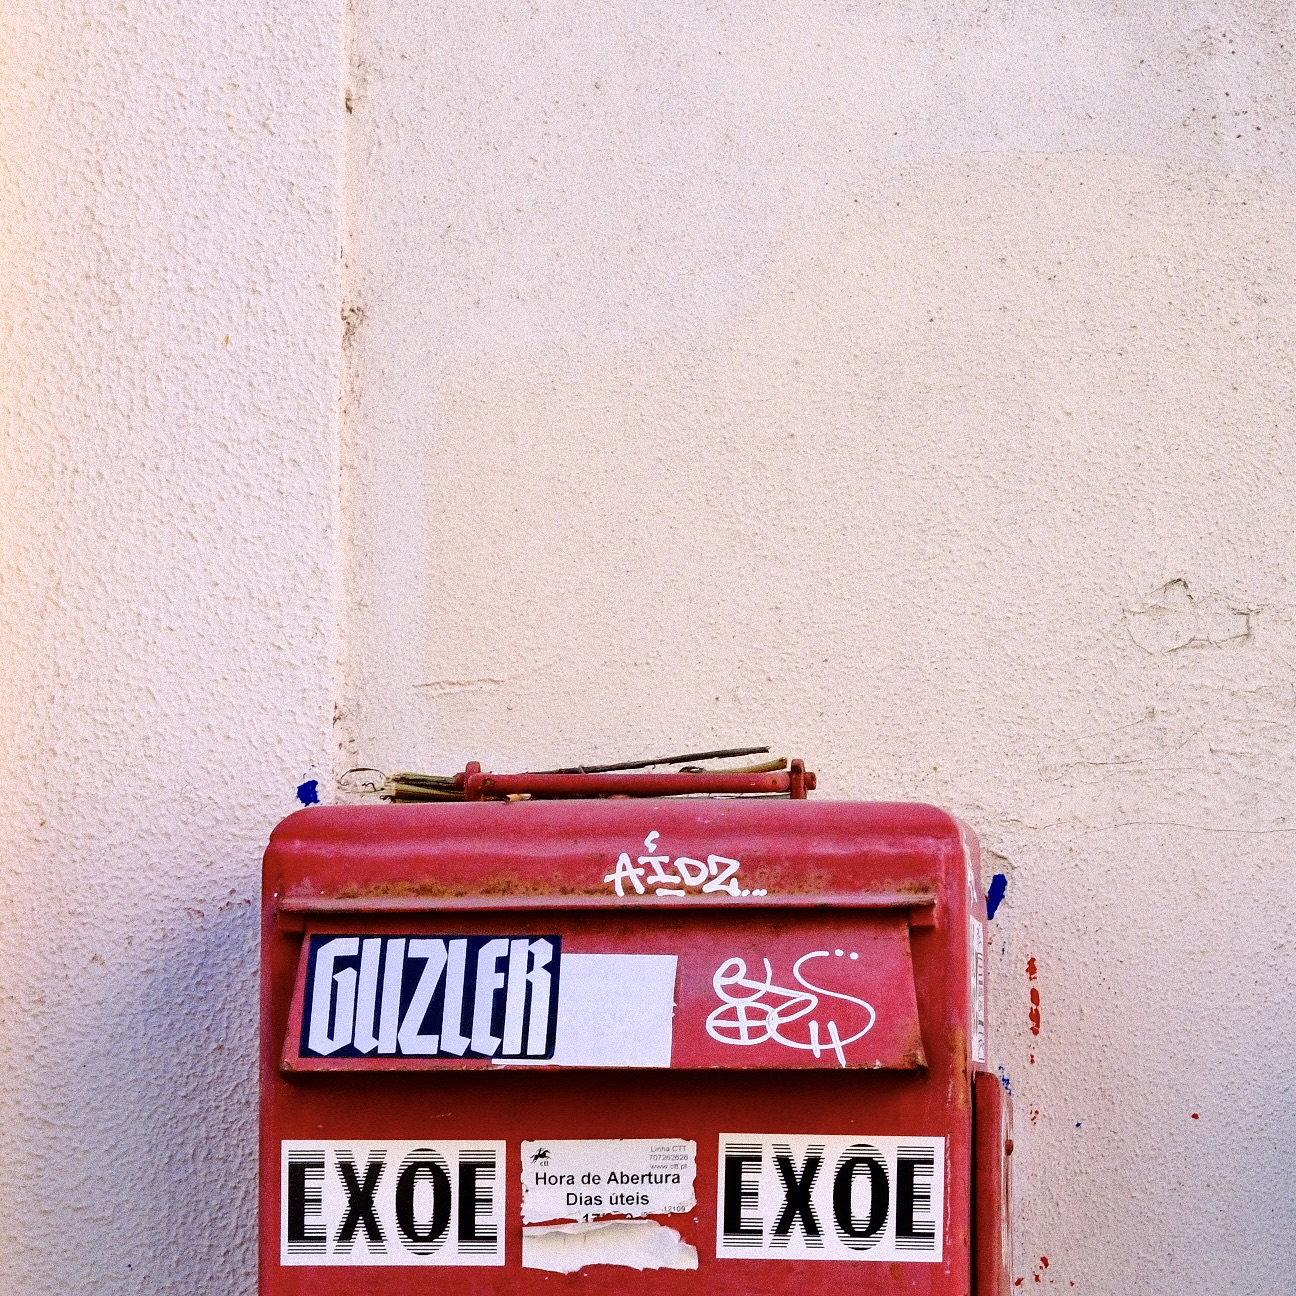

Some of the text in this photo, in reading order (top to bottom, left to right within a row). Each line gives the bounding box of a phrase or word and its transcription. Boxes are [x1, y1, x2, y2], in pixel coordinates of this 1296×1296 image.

[306, 936, 554, 1057] GUZLER
[287, 1147, 498, 1257] EXOE
[535, 1171, 681, 1186] Hora de Abertura
[566, 1192, 650, 1206] Dias úteis
[723, 1142, 936, 1254] EXOE
